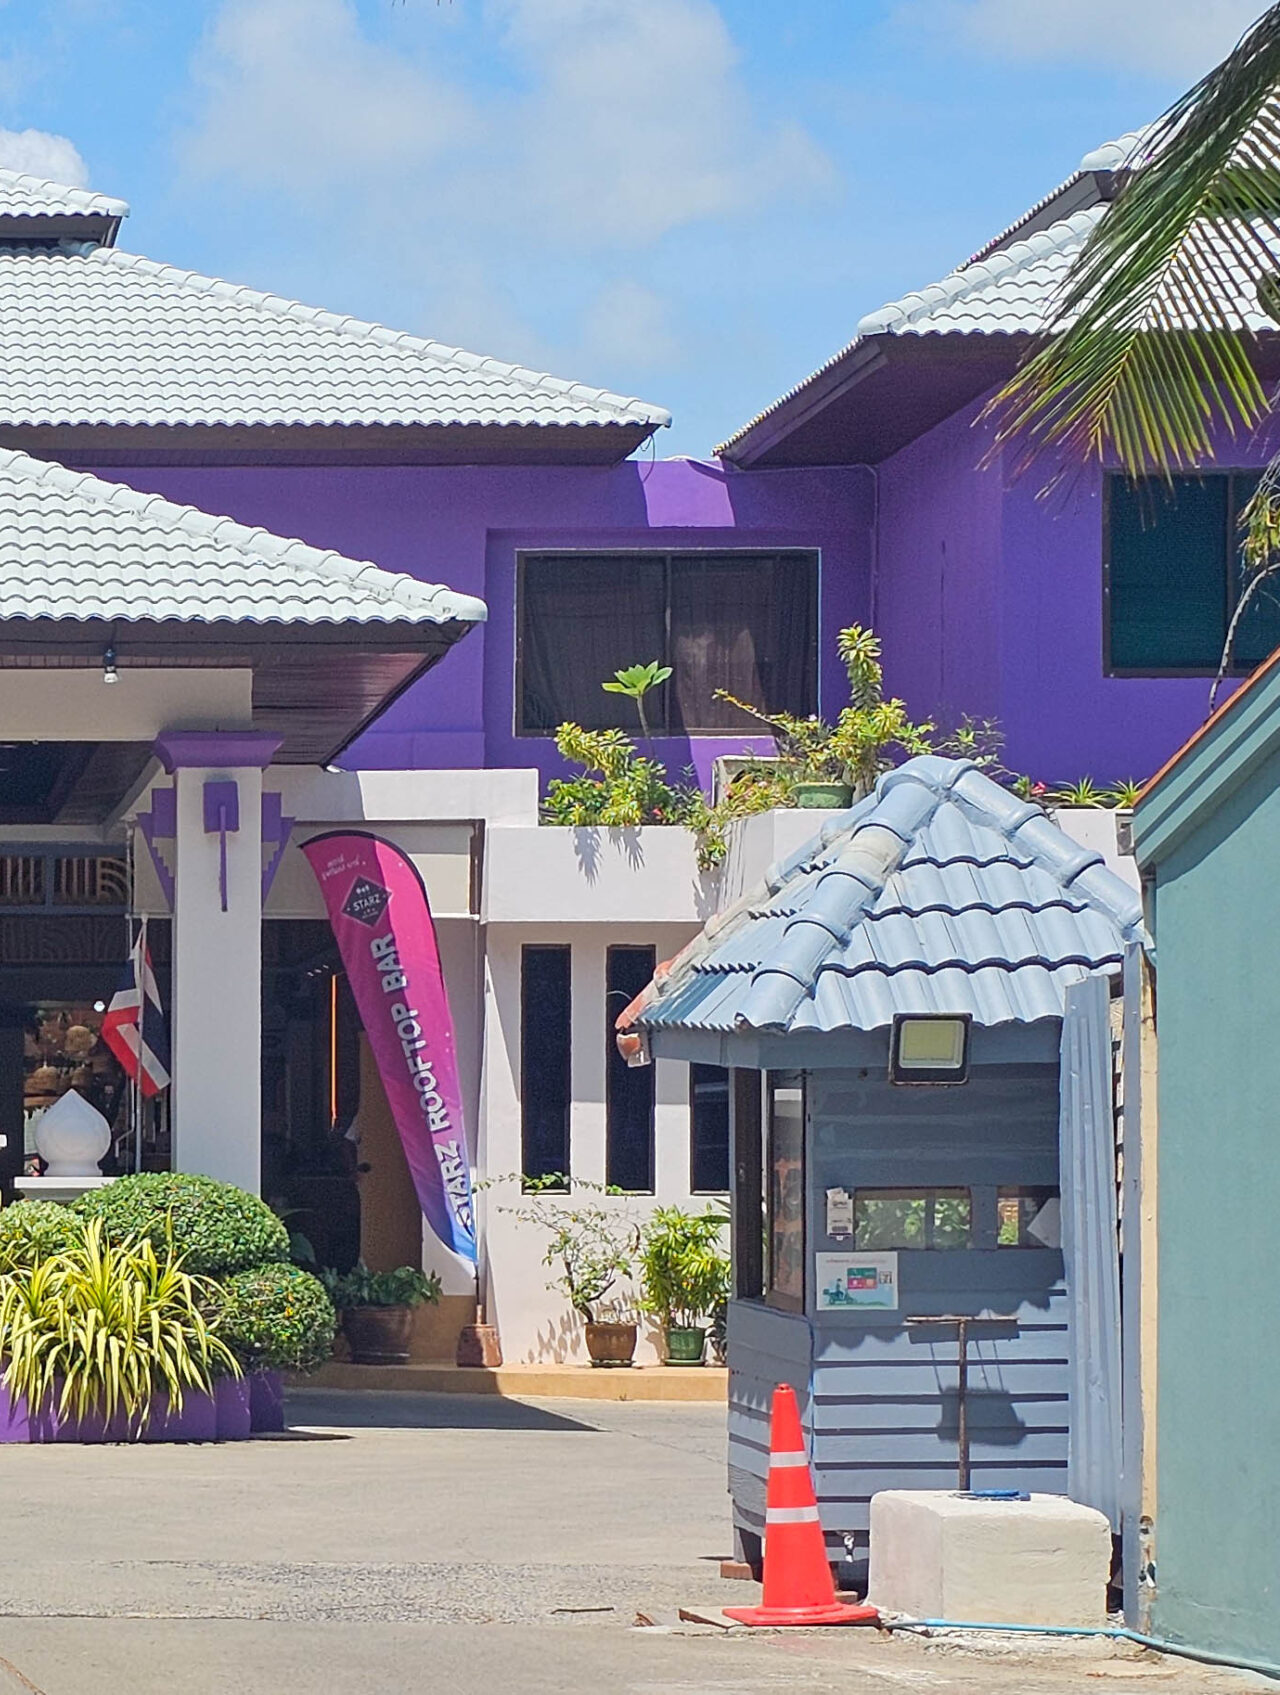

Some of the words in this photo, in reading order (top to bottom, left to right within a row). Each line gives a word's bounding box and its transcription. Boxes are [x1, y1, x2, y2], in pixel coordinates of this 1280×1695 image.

[352, 893, 381, 912] STARZ
[370, 932, 408, 993] BAR
[390, 1002, 452, 1132] ROOFTOP
[433, 1139, 472, 1227] STARZ
